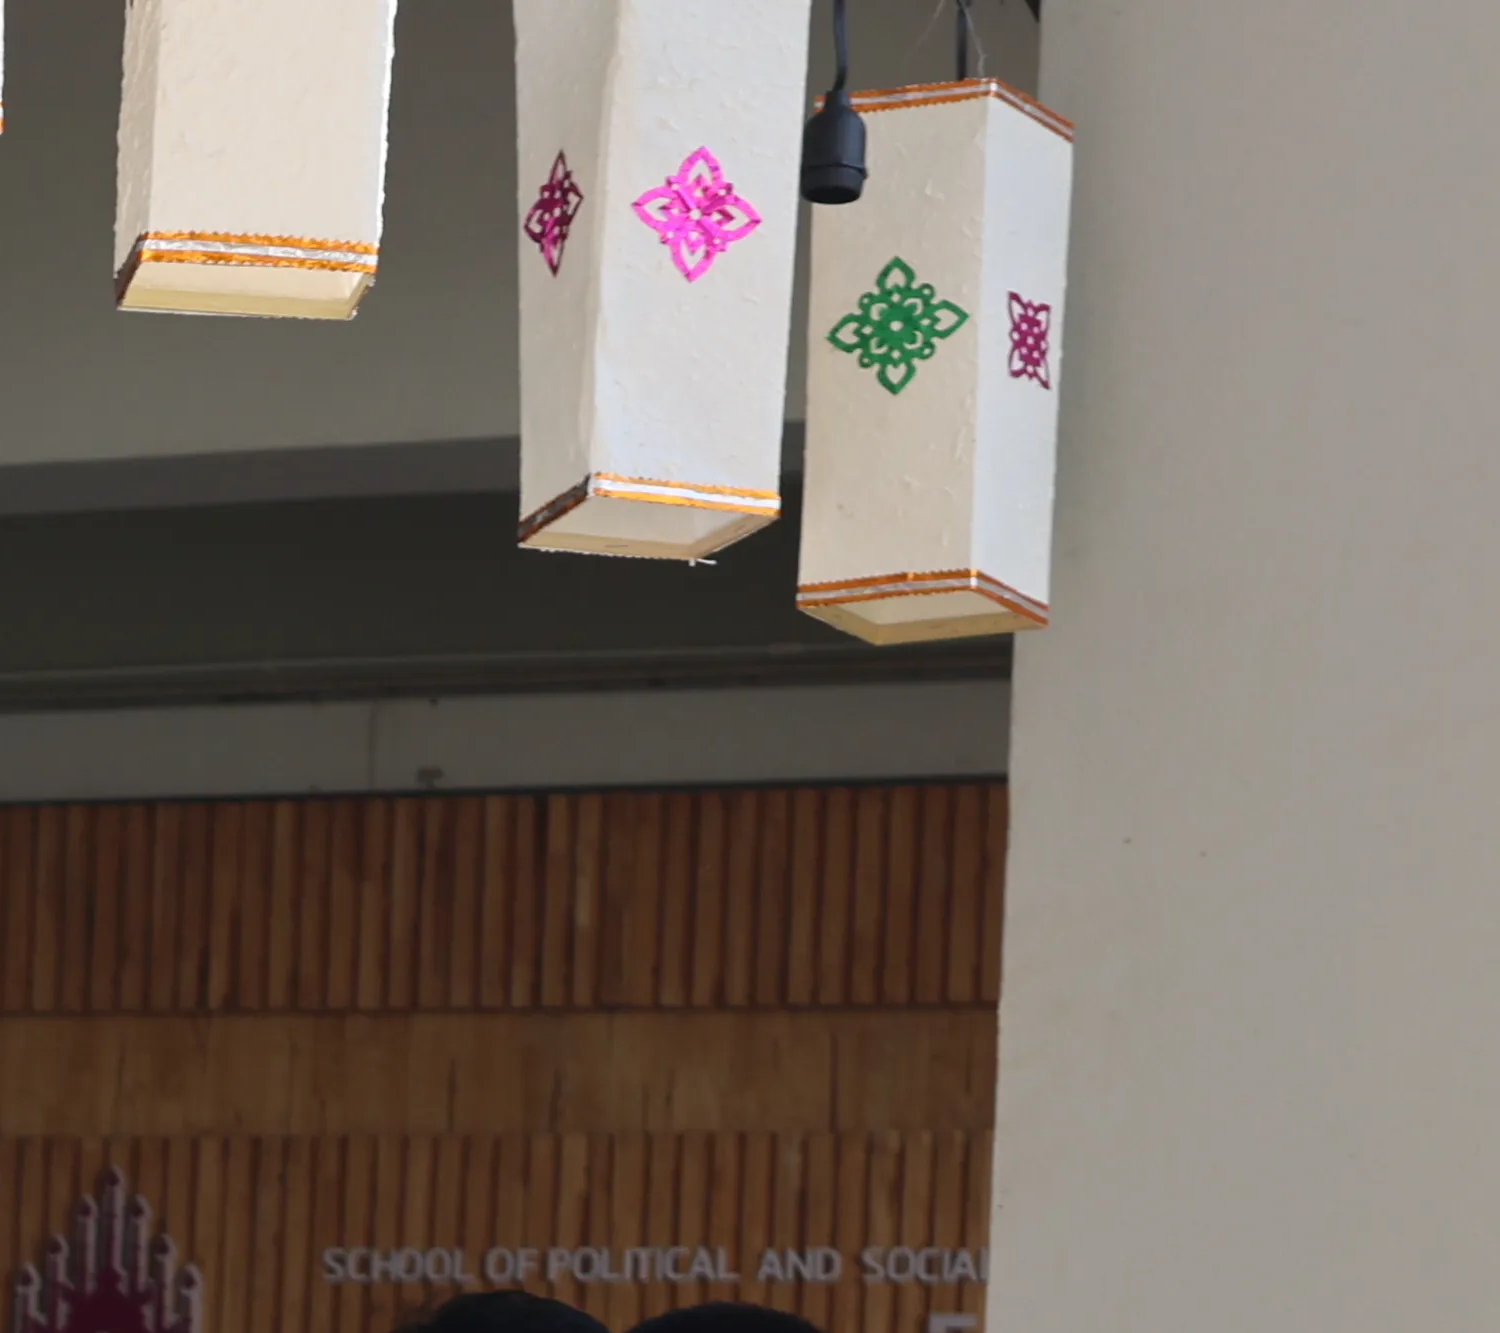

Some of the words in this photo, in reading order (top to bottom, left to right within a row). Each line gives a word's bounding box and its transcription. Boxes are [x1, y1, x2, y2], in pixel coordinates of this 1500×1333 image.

[322, 1246, 476, 1284] SCHOOL
[484, 1246, 539, 1284] OF
[546, 1246, 740, 1284] POLITICAL
[756, 1245, 843, 1284] AND
